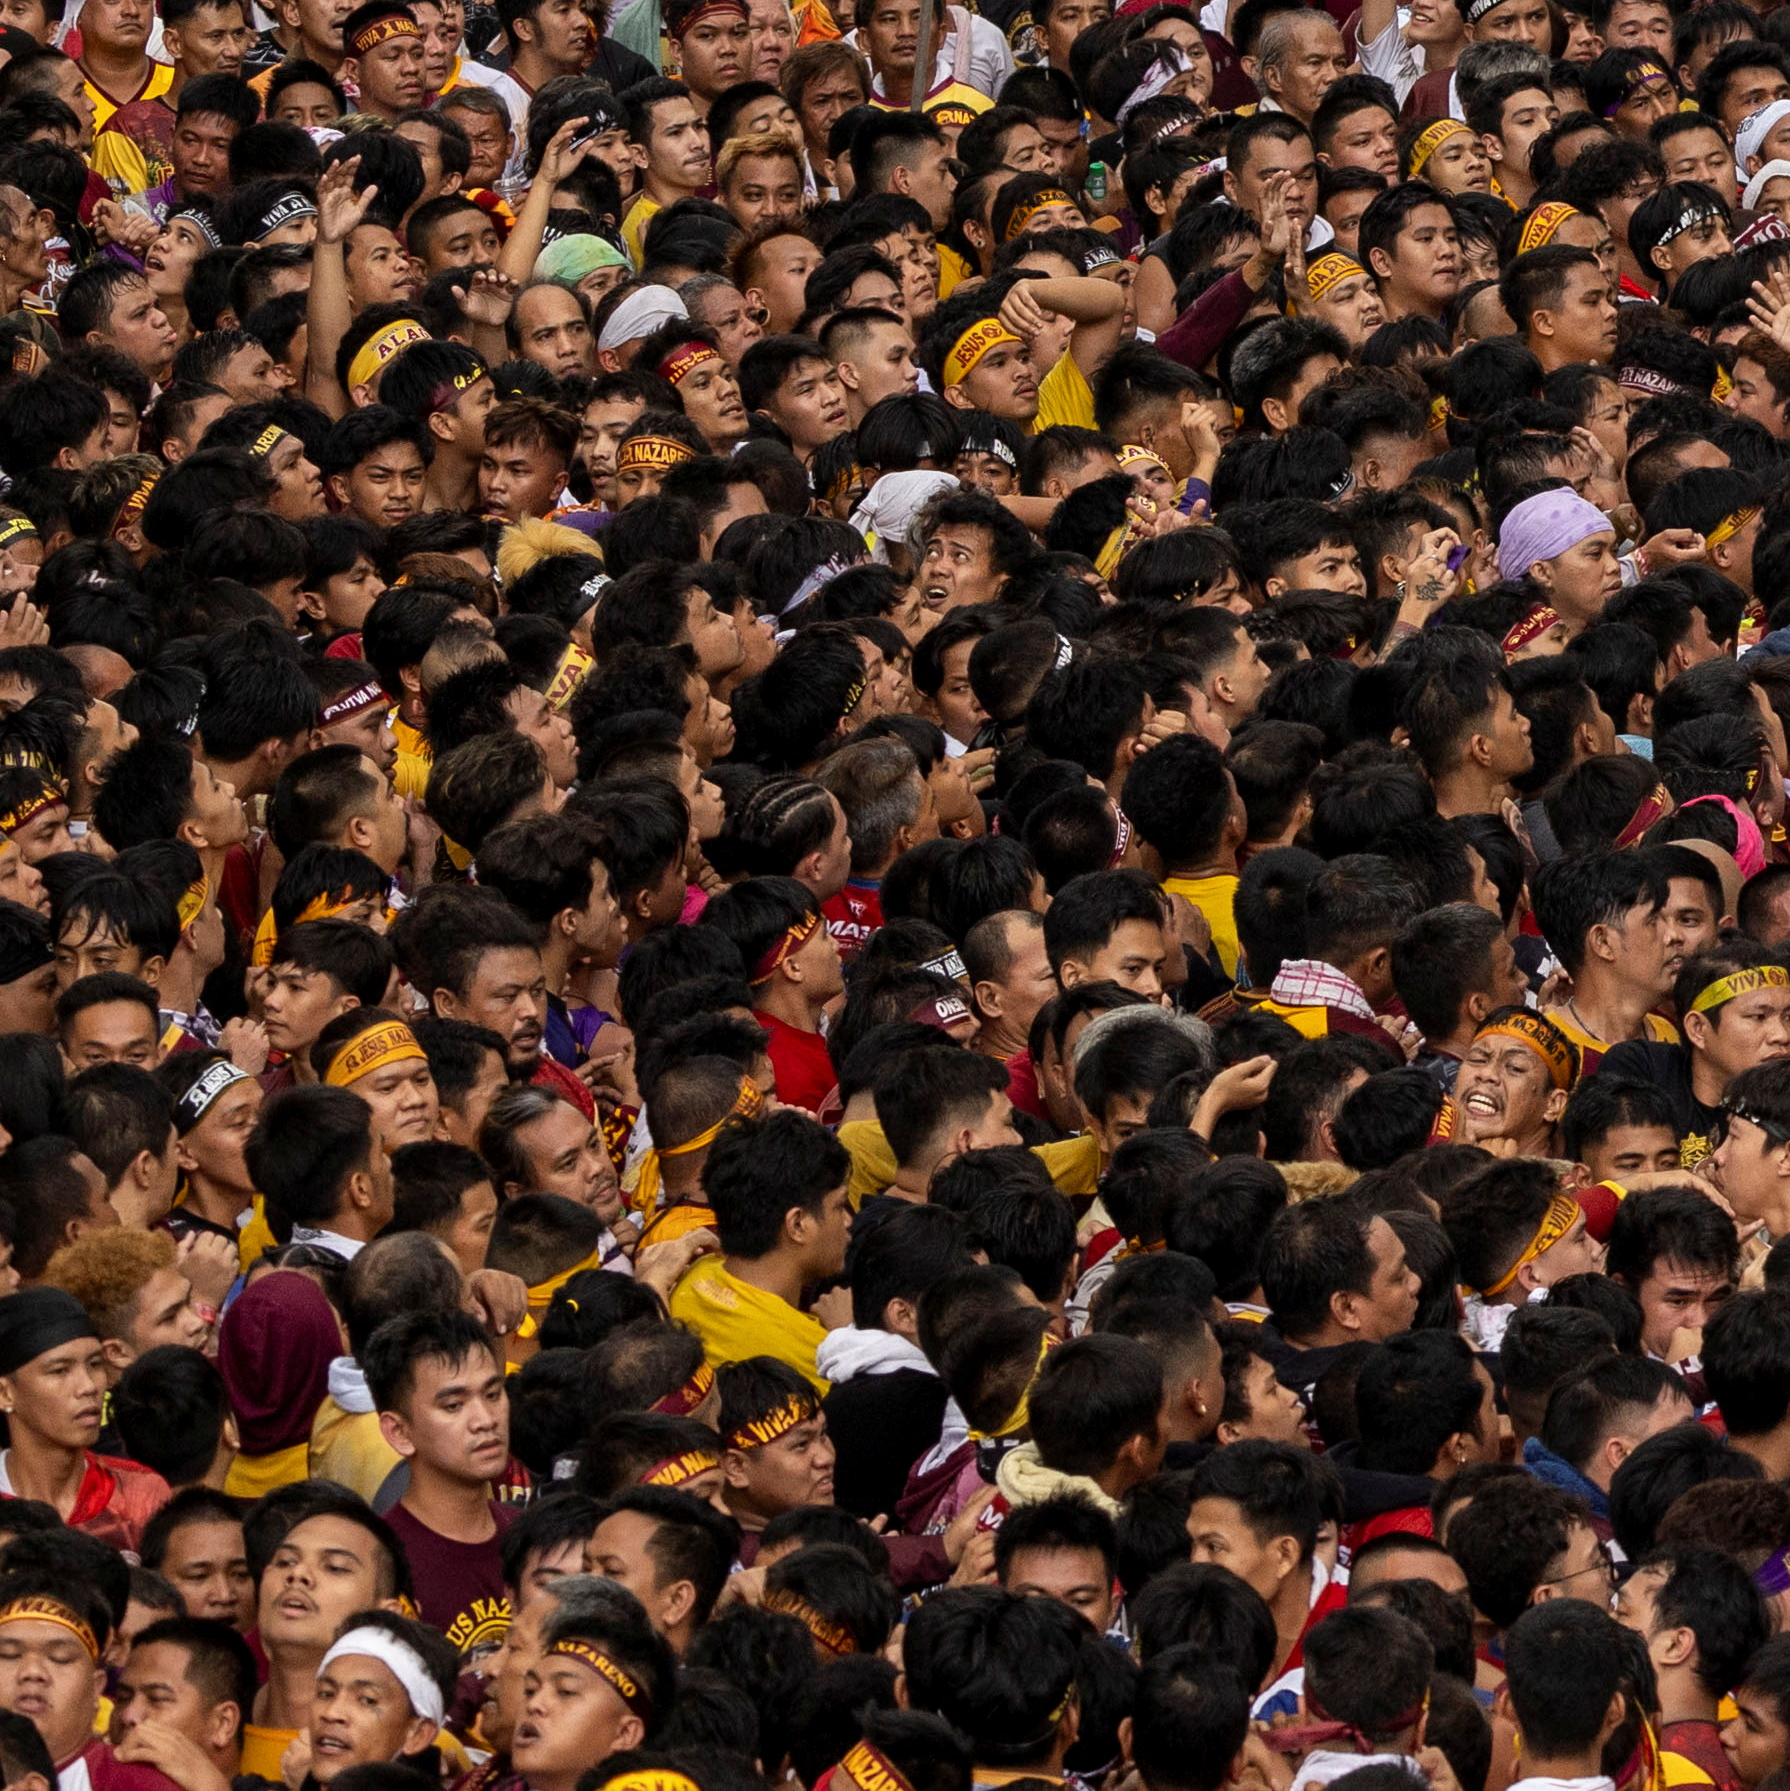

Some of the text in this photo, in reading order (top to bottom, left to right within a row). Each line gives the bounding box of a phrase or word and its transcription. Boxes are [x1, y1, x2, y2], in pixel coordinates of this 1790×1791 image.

[357, 23, 380, 54] VIVA
[1428, 122, 1453, 142] VIVA
[261, 204, 288, 227] VIVA
[955, 332, 987, 370] JESUS
[1726, 971, 1765, 996] VIVA
[1436, 1102, 1455, 1139] VIVA
